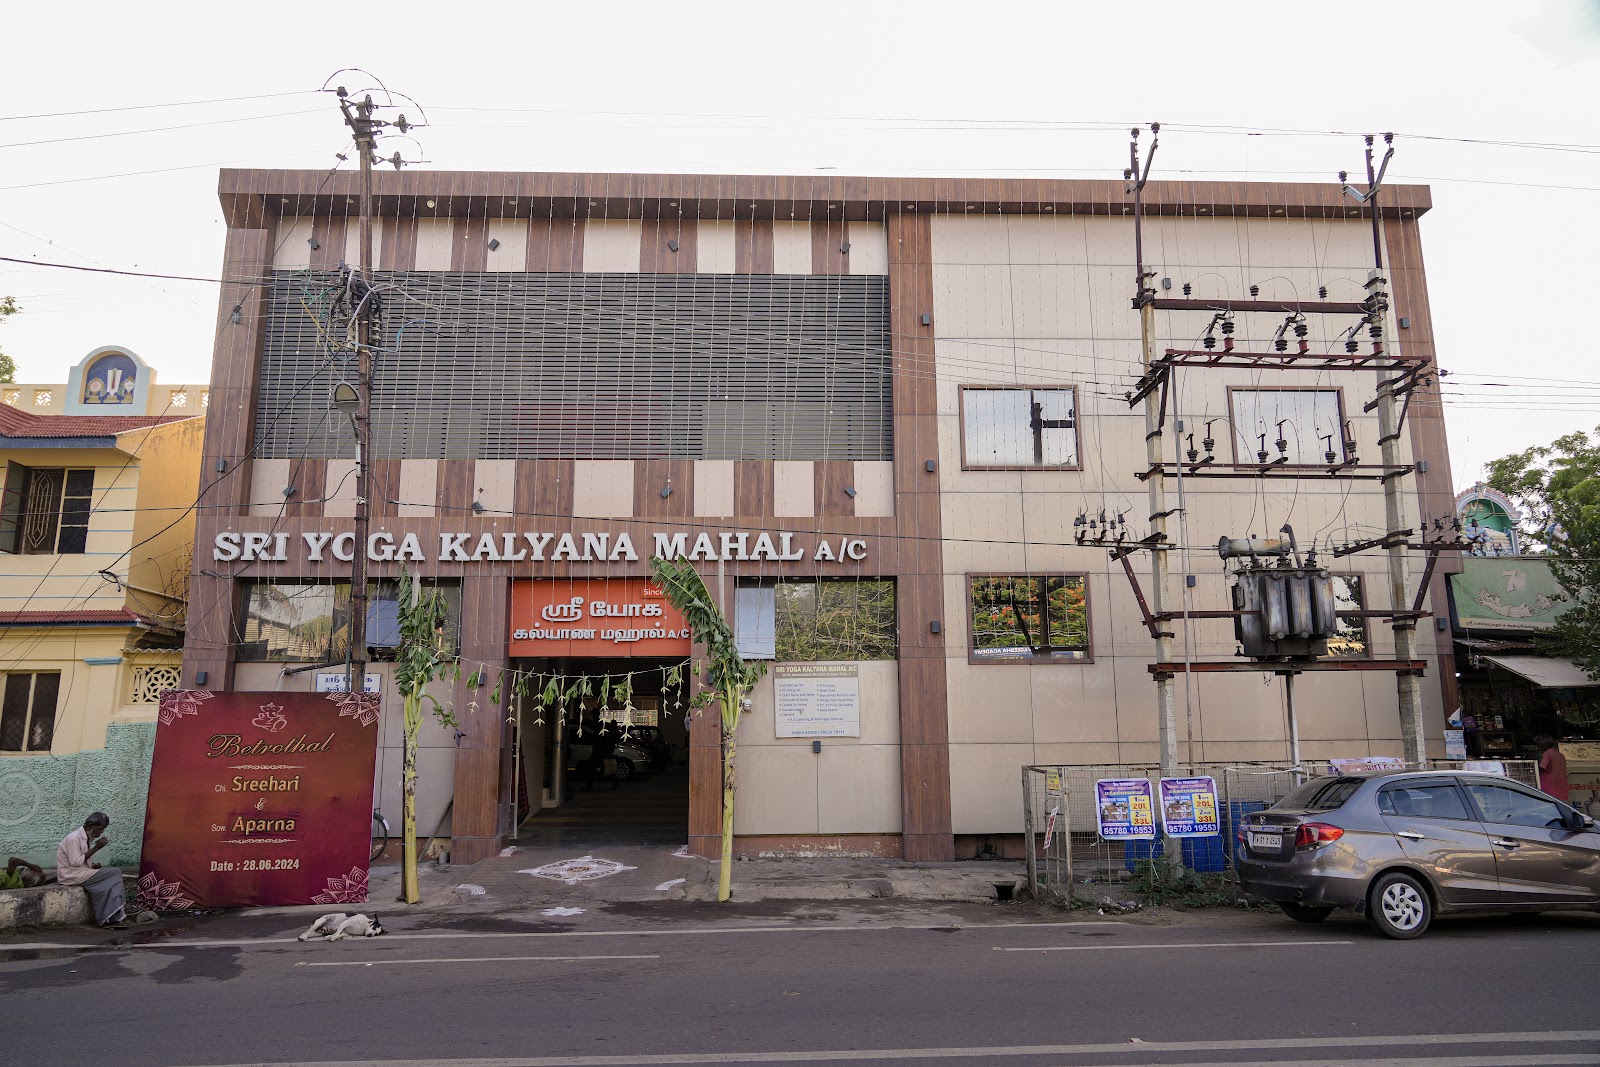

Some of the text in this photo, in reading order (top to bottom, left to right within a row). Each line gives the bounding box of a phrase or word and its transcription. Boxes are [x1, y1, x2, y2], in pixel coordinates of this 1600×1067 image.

[213, 532, 868, 563] SRI YOGA KALYANA MAHAL A/C
[589, 600, 663, 617] யோக
[513, 621, 597, 640] கல்யாண
[600, 621, 665, 644] மஹால்
[206, 732, 336, 758] Betrothal
[215, 775, 300, 793] Chi. Sreehari
[254, 797, 266, 811] &
[211, 816, 296, 836] Sow. Aparna
[1103, 826, 1153, 835] 95780 19553
[1168, 824, 1217, 833] 95780 19553
[210, 860, 234, 872] Date
[243, 858, 300, 871] 28.06.2024
